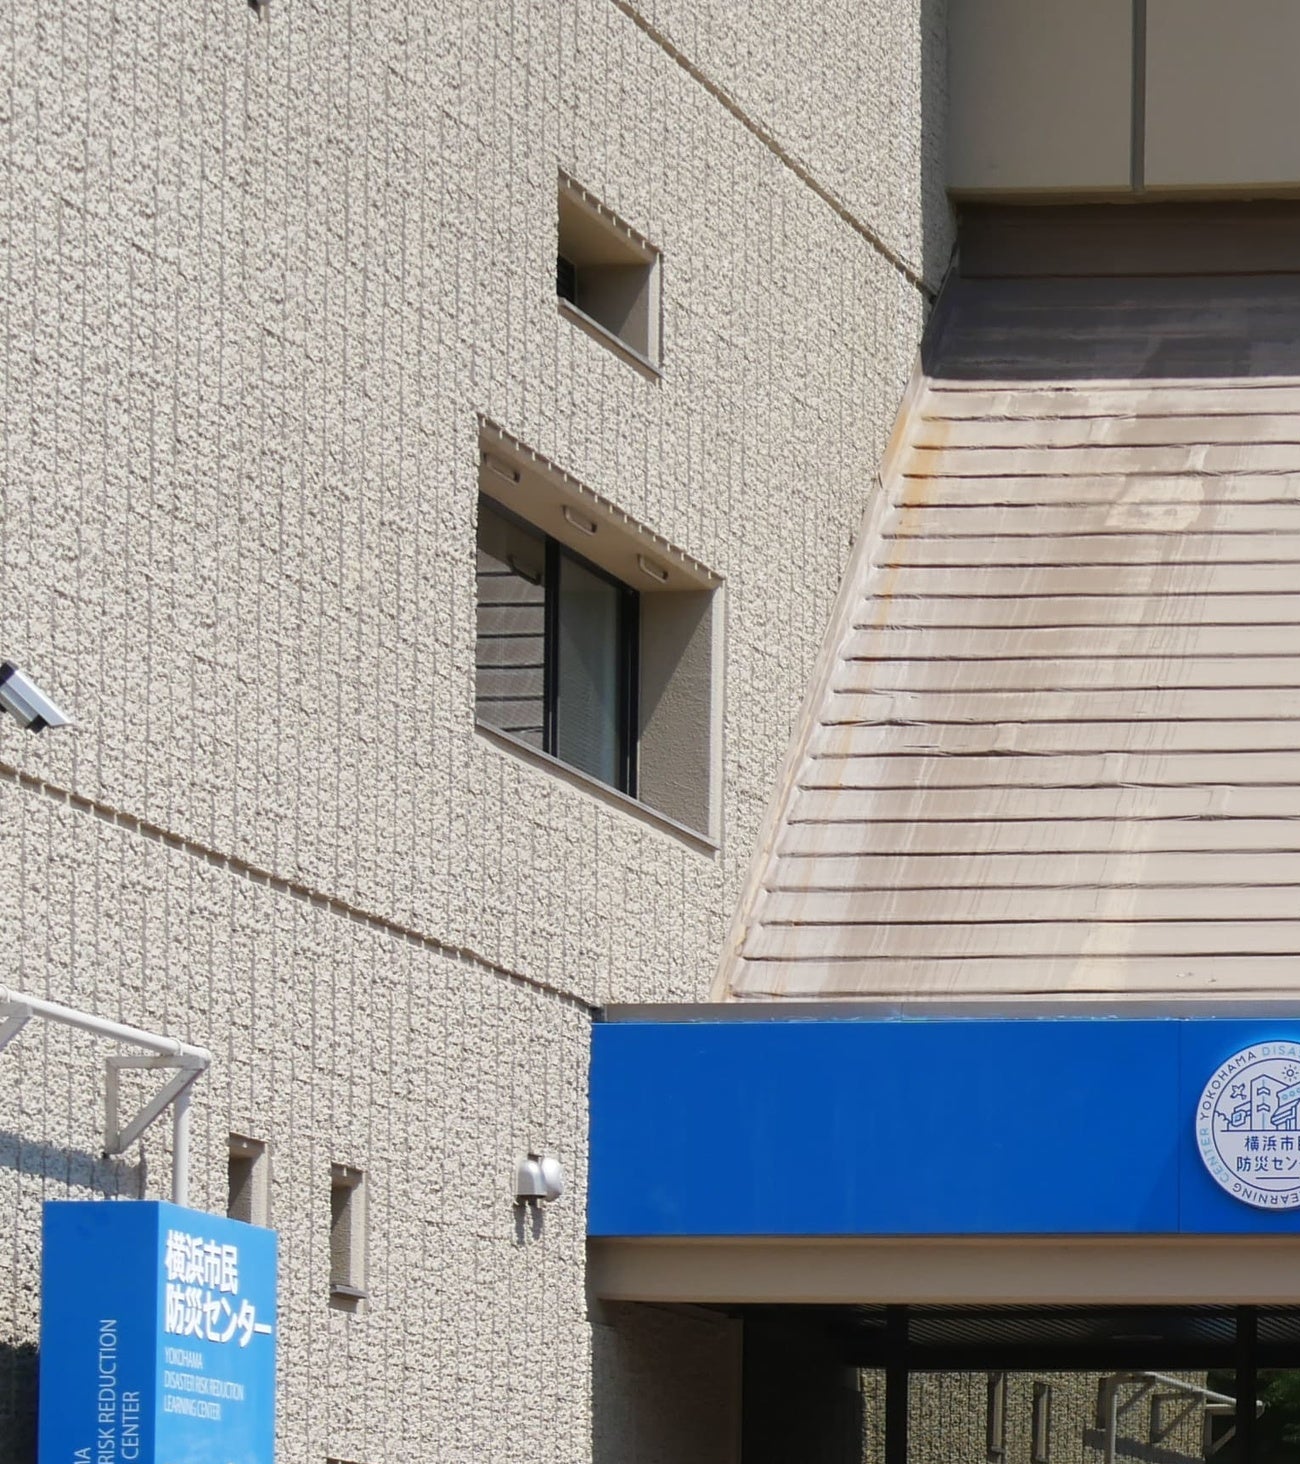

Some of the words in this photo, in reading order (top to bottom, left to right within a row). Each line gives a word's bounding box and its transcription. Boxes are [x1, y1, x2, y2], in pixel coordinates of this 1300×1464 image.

[1200, 1051, 1257, 1121] YOKOHAMA
[1200, 1126, 1231, 1184] CENTER
[164, 1228, 239, 1296] 横浜市民
[163, 1282, 273, 1348] 防災センター
[98, 1319, 117, 1423] REDUCTION
[163, 1370, 196, 1394] DISASTER
[164, 1346, 203, 1369] YOKOHAMA
[121, 1390, 140, 1461] CENTER
[163, 1394, 197, 1417] LEARNING
[198, 1399, 222, 1421] CENTER
